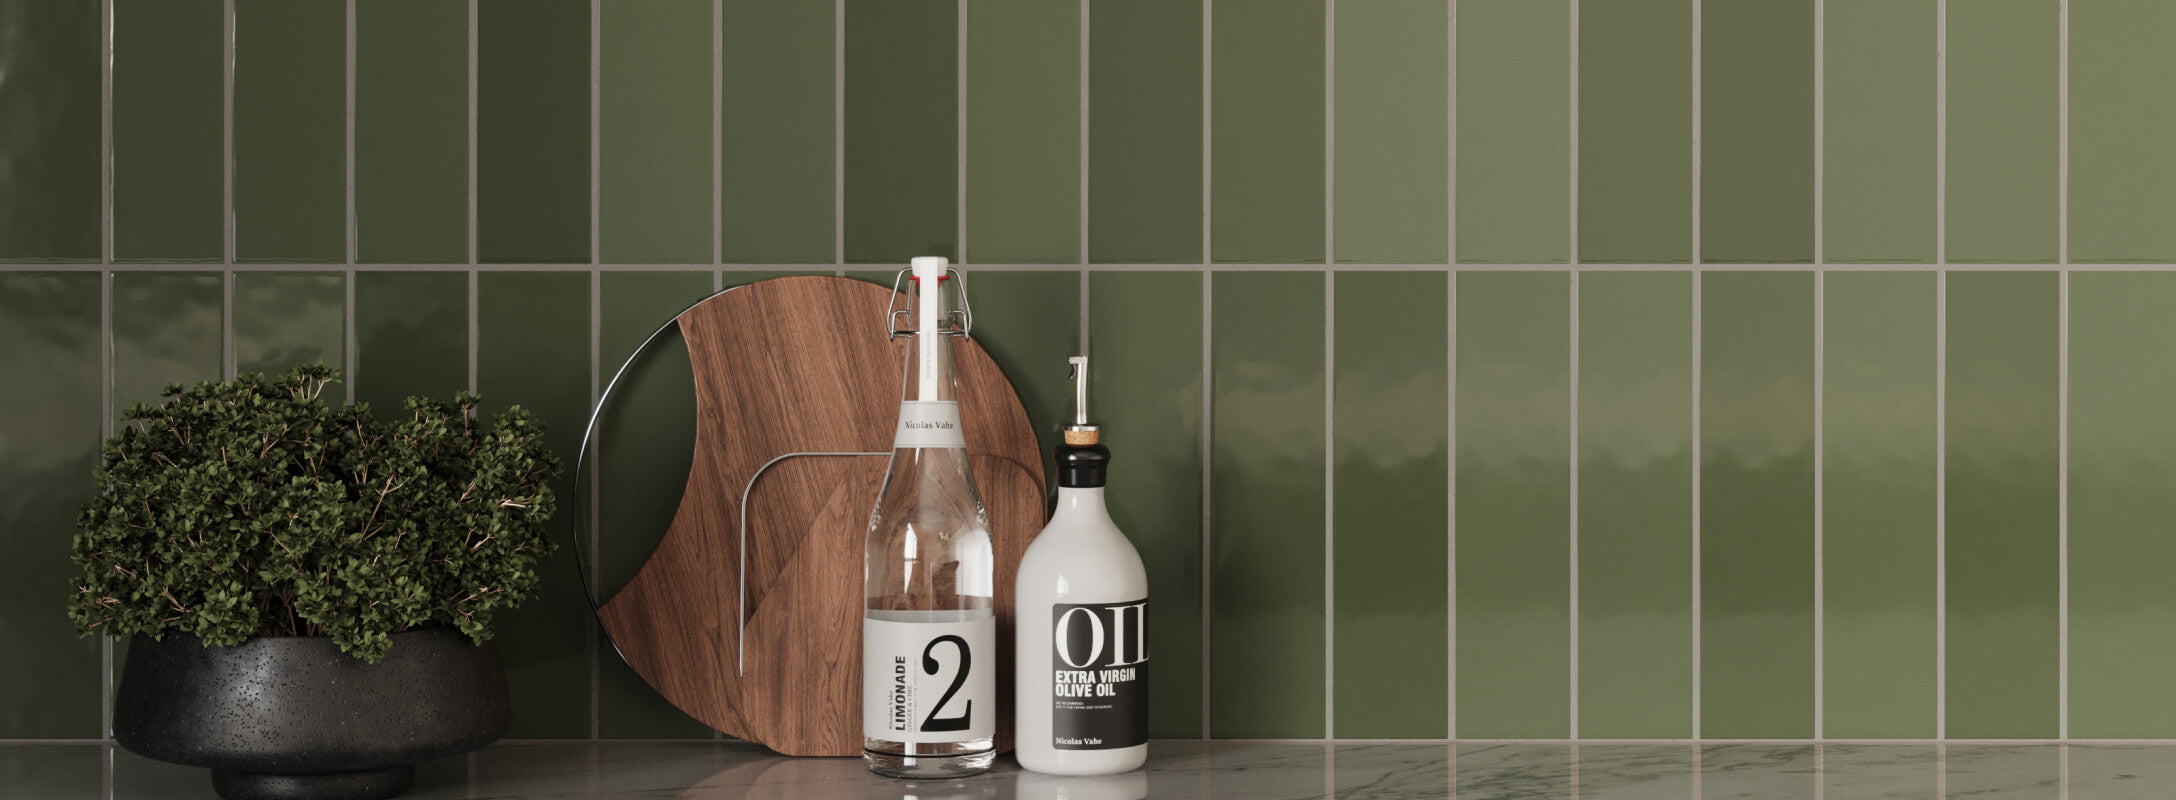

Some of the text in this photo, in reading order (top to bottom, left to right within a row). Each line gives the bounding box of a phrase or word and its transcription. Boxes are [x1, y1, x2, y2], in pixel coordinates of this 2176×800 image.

[905, 420, 933, 429] Nicolas
[920, 634, 972, 732] 2
[1056, 667, 1136, 684] EXTRA VIRGIN
[895, 656, 906, 731] LIMONADE
[1056, 684, 1116, 697] OLIVE OIL
[1056, 737, 1082, 745] Nicolas
